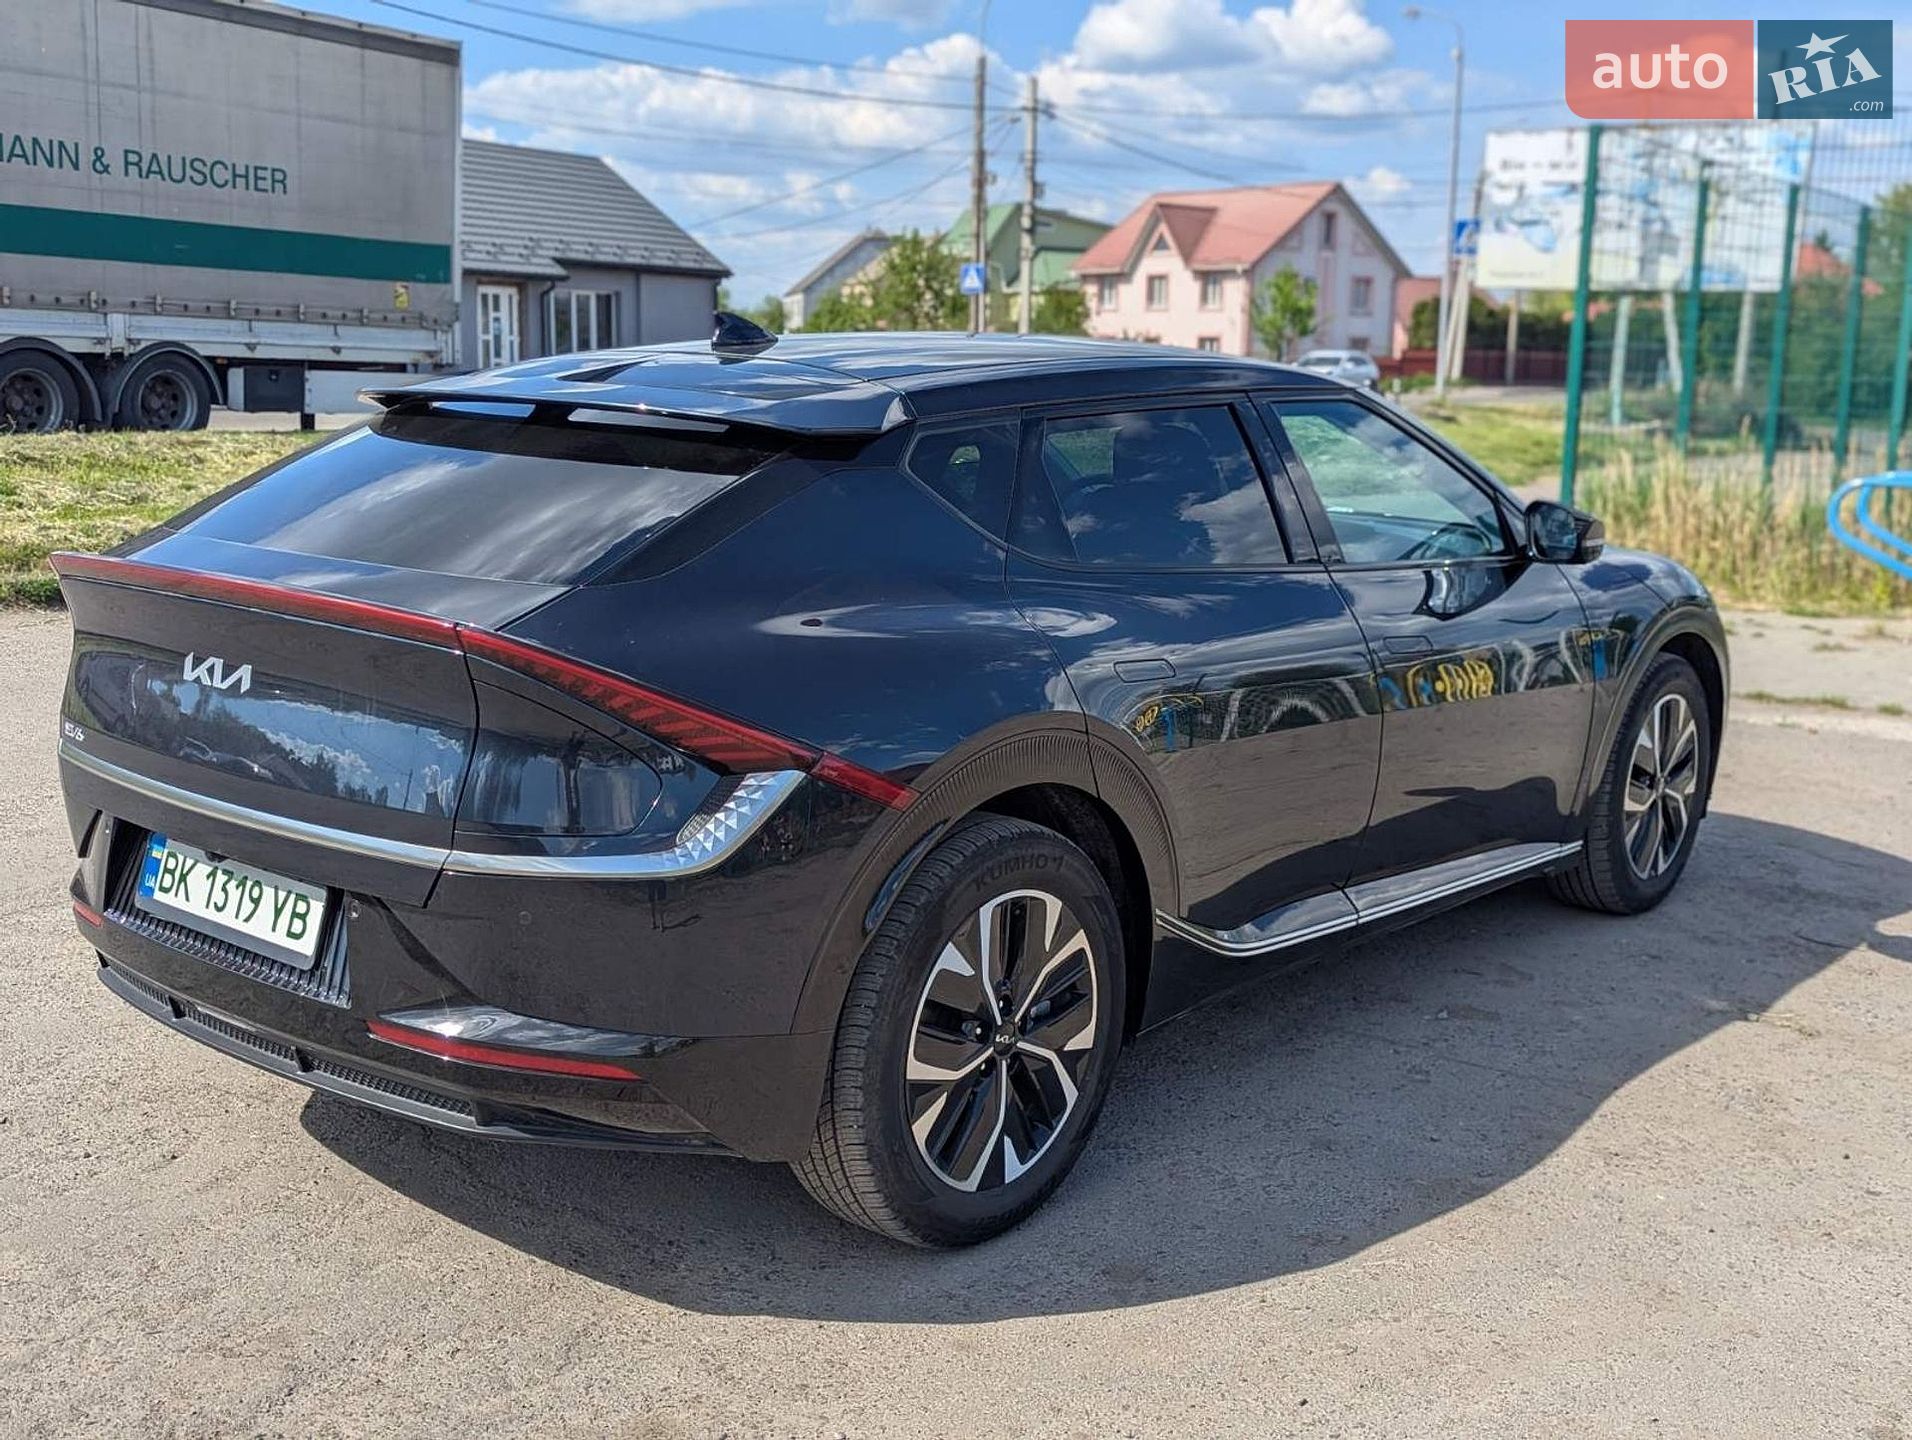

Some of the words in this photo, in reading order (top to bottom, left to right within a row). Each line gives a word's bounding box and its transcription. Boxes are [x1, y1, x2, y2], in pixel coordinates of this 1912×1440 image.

[92, 146, 112, 175] &
[123, 149, 288, 195] RAUSCHER
[183, 652, 252, 694] KIA
[145, 873, 156, 889] UA
[158, 851, 200, 902] BK
[206, 866, 263, 923] 1319
[272, 885, 311, 940] YB
